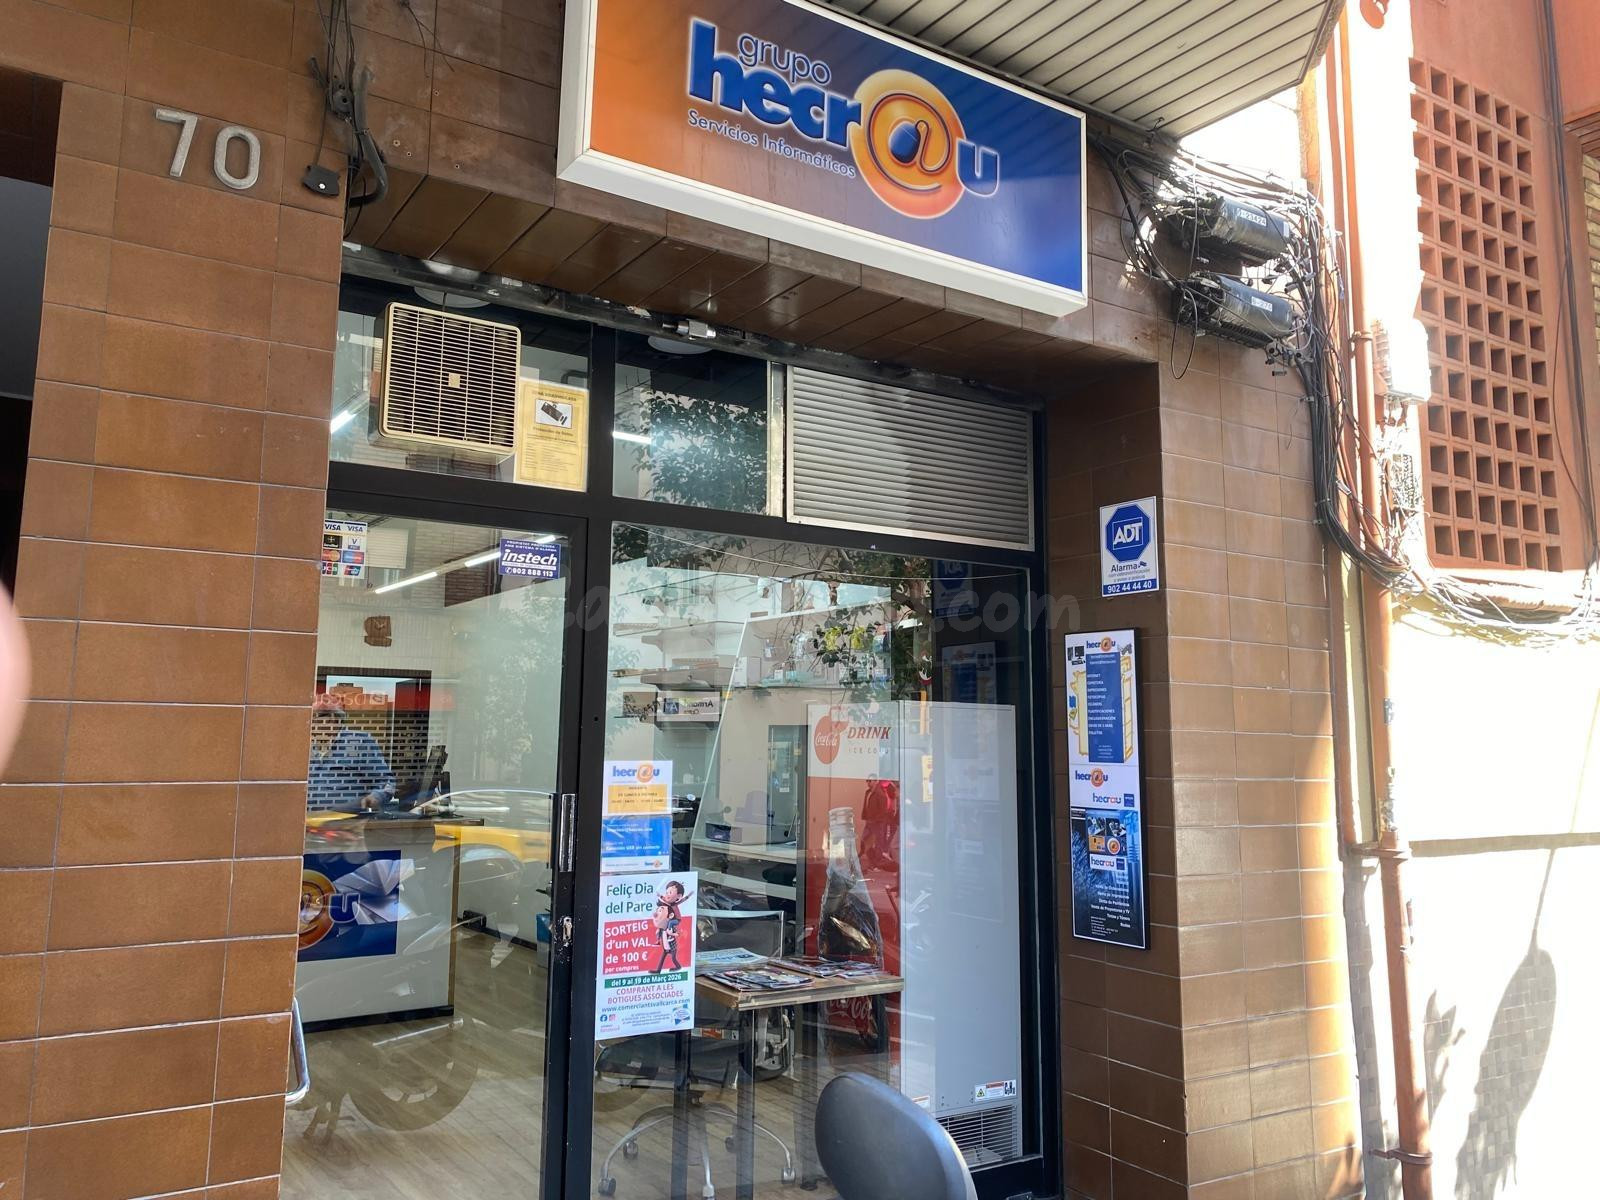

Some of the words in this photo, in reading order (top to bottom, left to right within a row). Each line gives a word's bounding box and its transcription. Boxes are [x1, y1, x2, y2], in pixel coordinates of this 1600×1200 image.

[737, 33, 832, 85] grupo
[687, 16, 1001, 219] hecr@u
[155, 108, 261, 189] 70
[688, 109, 758, 147] Servicios
[763, 131, 856, 178] Informáticos
[325, 523, 341, 531] VISA
[1113, 522, 1143, 545] ADT
[502, 549, 558, 565] instech
[1111, 564, 1138, 573] Alarma
[1107, 584, 1121, 594] 902
[1122, 583, 1131, 591] 44
[1132, 582, 1141, 590] 44
[1143, 580, 1152, 589] 40
[848, 726, 892, 740] DRINK
[606, 883, 632, 898] Feliç
[635, 882, 654, 894] Dia
[605, 901, 624, 914] del
[626, 901, 653, 913] Pare
[605, 921, 648, 938] SORTEIG
[631, 937, 651, 949] VAL
[605, 954, 619, 964] de
[622, 952, 639, 963] 100
[641, 951, 648, 961] €
[611, 979, 621, 987] del
[634, 977, 642, 985] 19
[642, 976, 650, 984] de
[651, 975, 667, 983] Març
[667, 973, 682, 981] 2026
[607, 994, 642, 1005] BOTIGUES
[642, 990, 684, 1000] ASSOCIADES
[616, 985, 656, 996] COMPRANT
